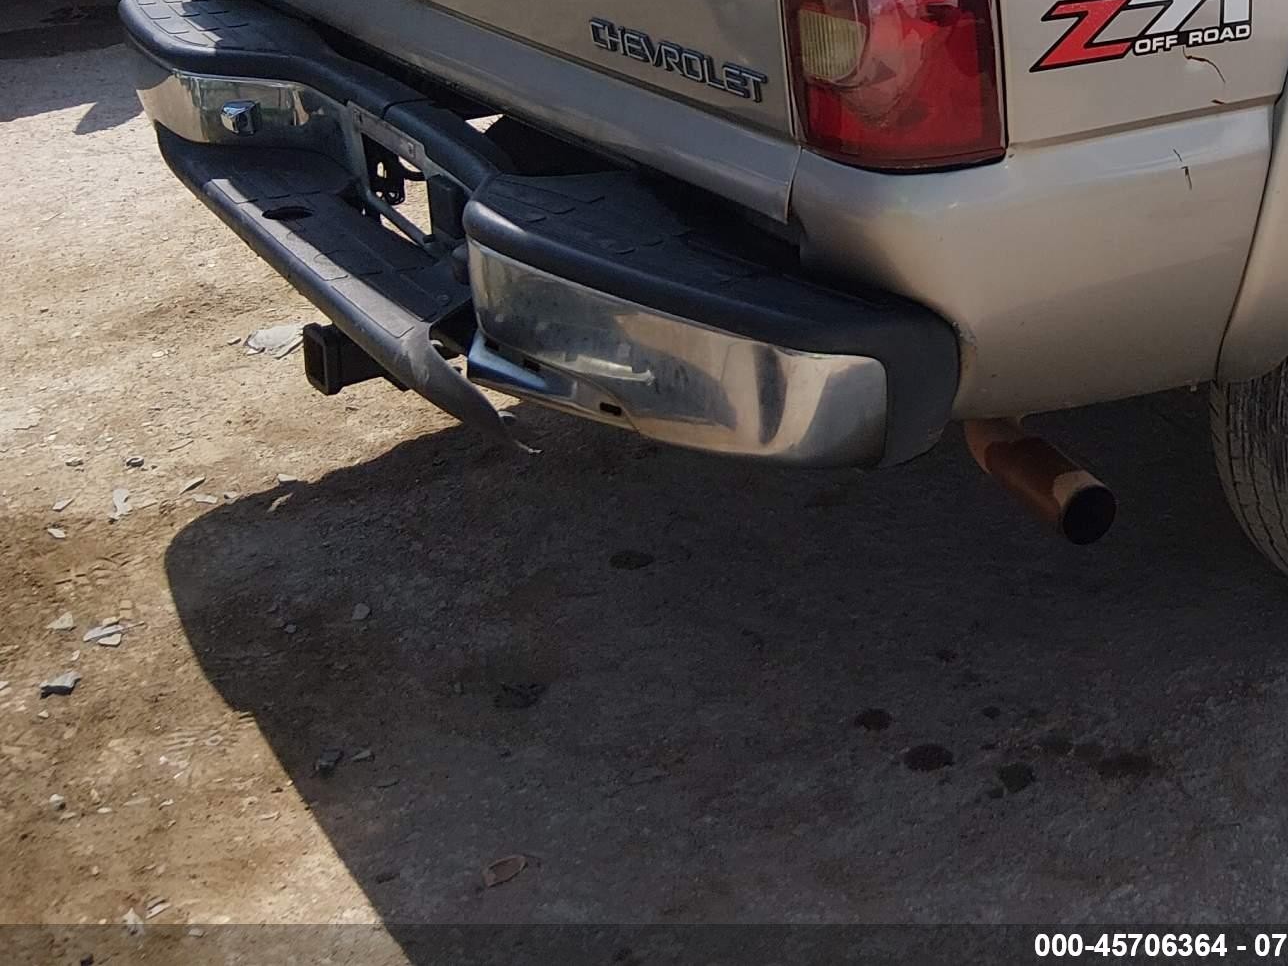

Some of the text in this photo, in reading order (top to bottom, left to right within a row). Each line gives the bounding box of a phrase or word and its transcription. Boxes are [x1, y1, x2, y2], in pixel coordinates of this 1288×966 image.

[588, 16, 768, 103] CHEVROLET
[1133, 23, 1251, 55] OFF ROAD
